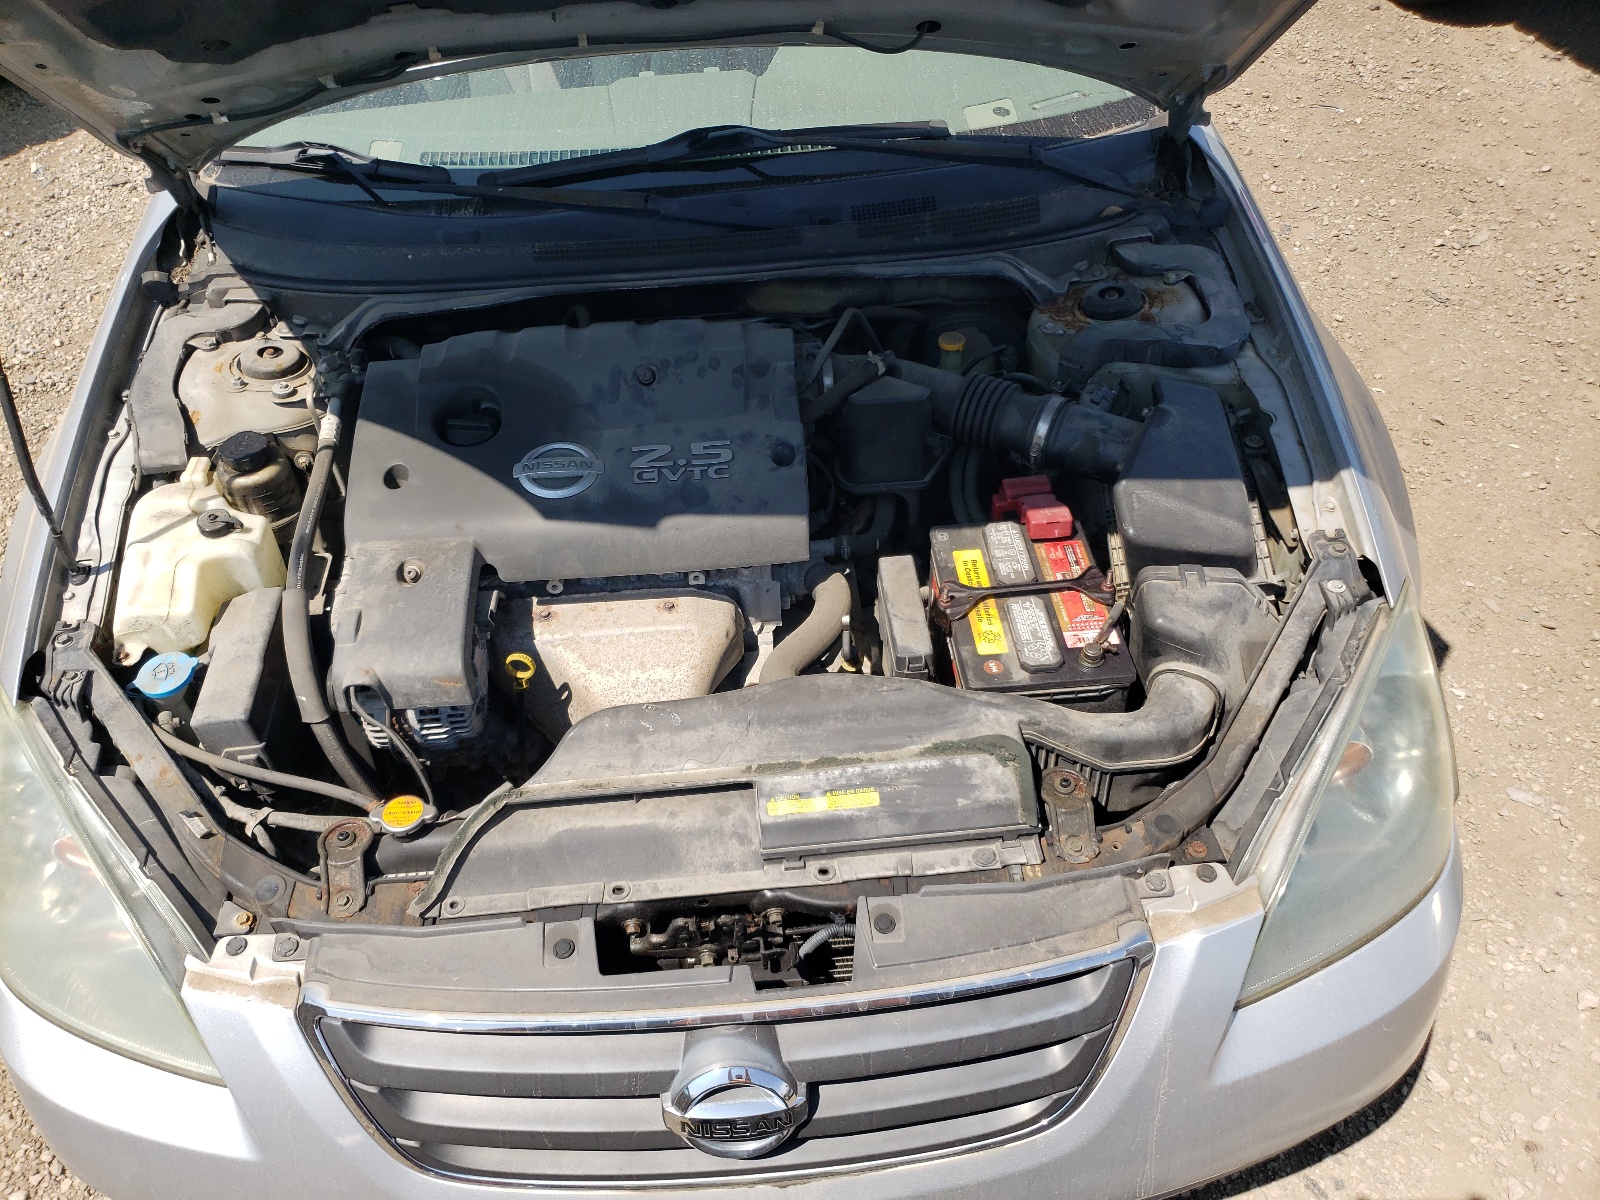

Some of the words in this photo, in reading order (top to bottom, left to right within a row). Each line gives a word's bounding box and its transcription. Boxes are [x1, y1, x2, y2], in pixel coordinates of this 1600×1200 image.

[522, 460, 593, 472] NISSAN
[630, 440, 733, 468] 2.5
[970, 559, 981, 580] Return
[680, 1110, 795, 1139] NISSAN
